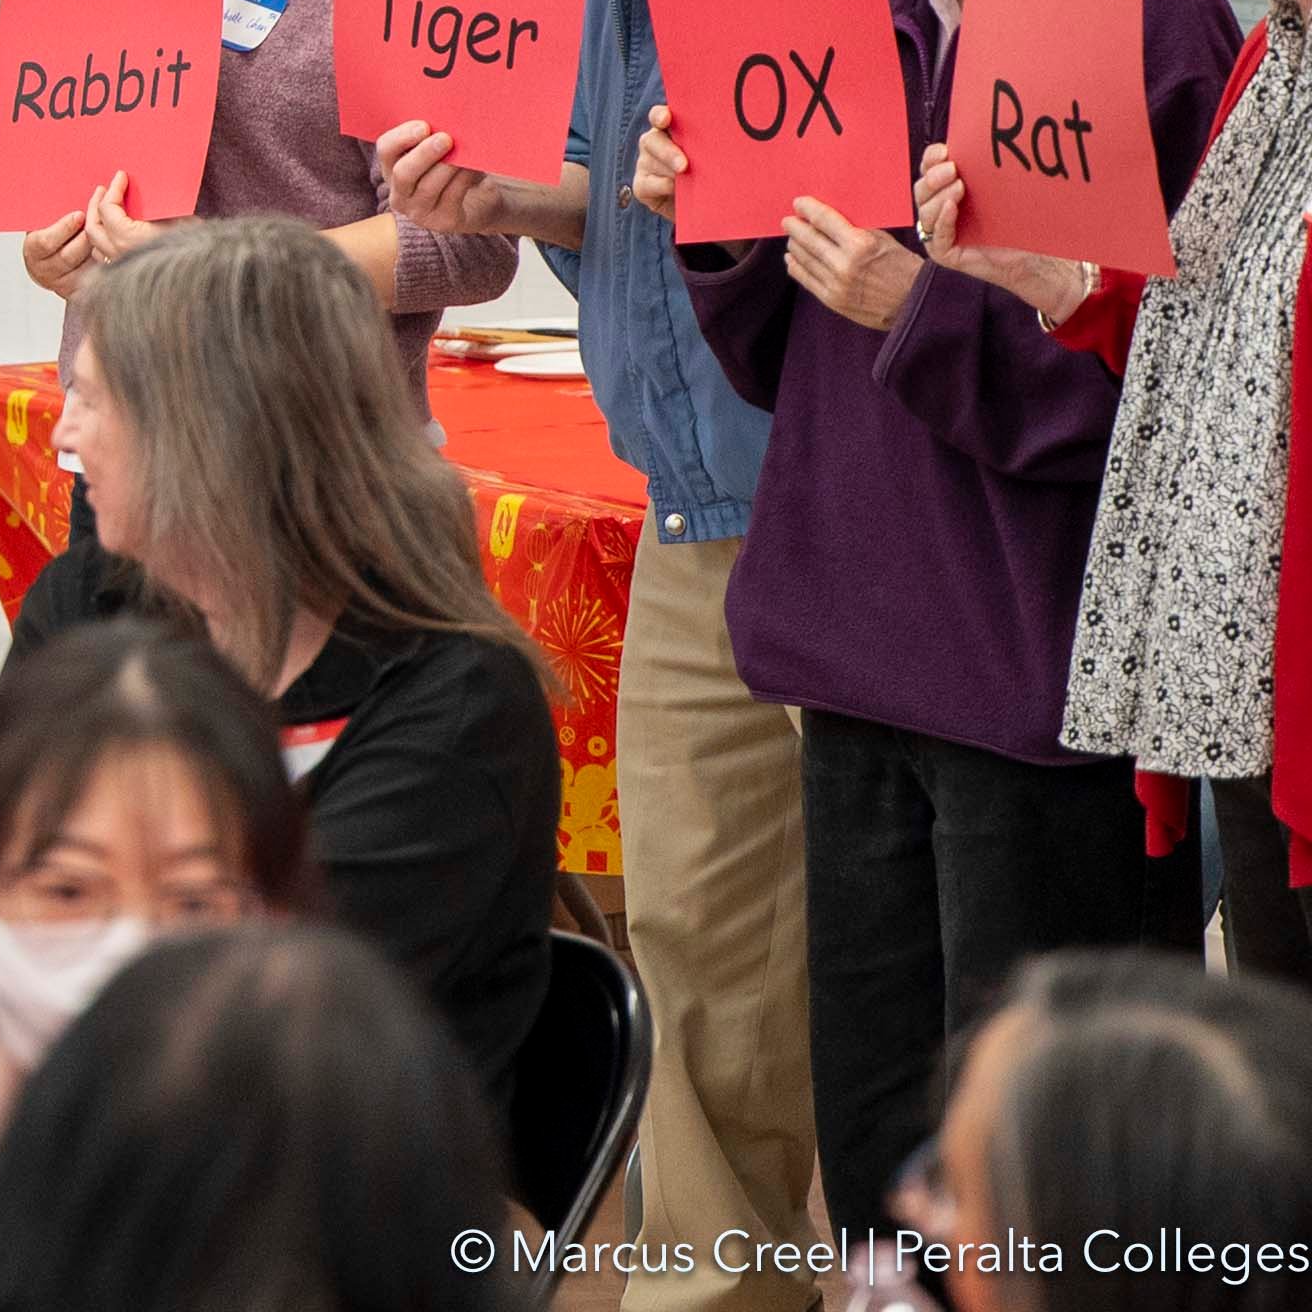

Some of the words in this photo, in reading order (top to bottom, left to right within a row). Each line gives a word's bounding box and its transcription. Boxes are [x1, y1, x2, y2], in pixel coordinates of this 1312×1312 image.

[13, 50, 192, 122] Rabbit
[734, 47, 844, 141] OX
[991, 79, 1092, 183] Rat
